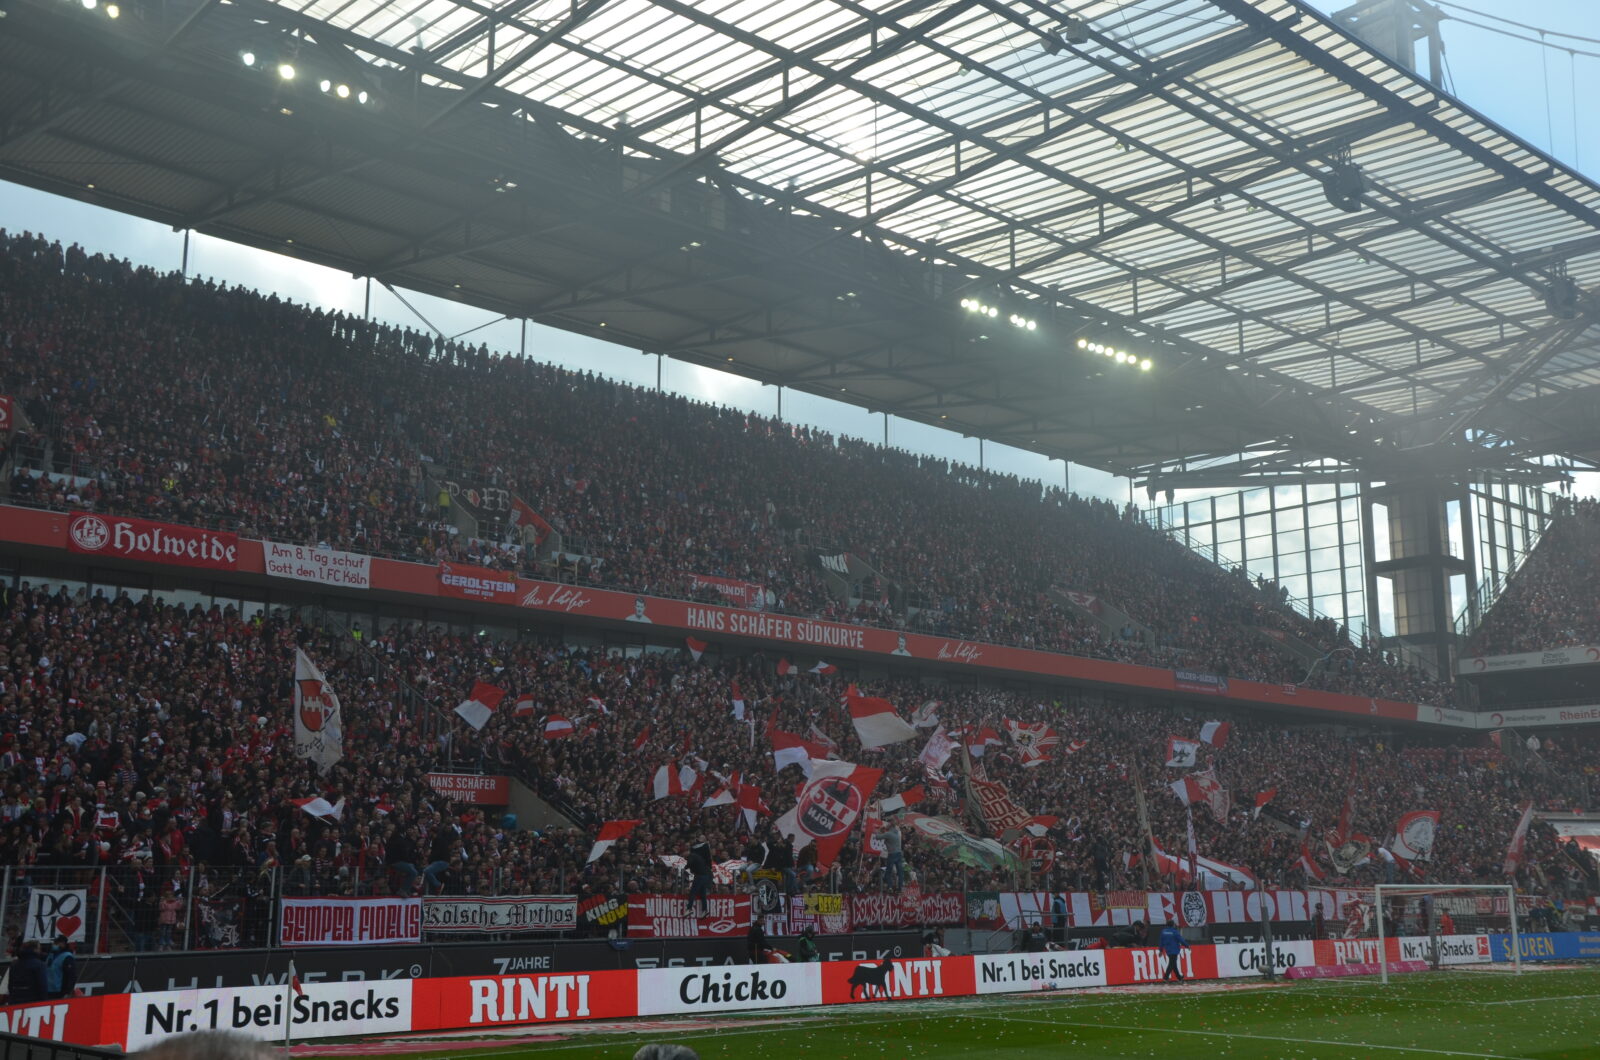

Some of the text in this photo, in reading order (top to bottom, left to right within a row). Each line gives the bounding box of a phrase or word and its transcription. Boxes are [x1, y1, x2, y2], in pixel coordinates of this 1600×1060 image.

[113, 522, 236, 563] Holweide
[272, 544, 365, 569] Am 8. Tag schuf
[268, 560, 292, 575] Gott
[296, 565, 316, 579] den
[343, 570, 367, 585] Köln
[441, 573, 516, 593] GEROLSTEIN
[687, 608, 864, 649] HANS SCHÄFER SÜDKURVE
[430, 776, 496, 790] HANS SCHÄFER
[37, 893, 82, 917] DO
[424, 903, 498, 926] Kölsche
[506, 902, 574, 925] Mythos
[585, 898, 619, 922] KING
[598, 902, 628, 925] NOW
[1000, 892, 1180, 930] WILDE
[282, 904, 354, 942] SEMPER
[358, 904, 420, 941] FIDELIS
[653, 918, 699, 937] STADION
[1442, 939, 1474, 957] Snacks
[494, 956, 550, 975] 7 JAHRE
[1021, 958, 1046, 980] bei
[1049, 956, 1100, 979] Snacks
[469, 975, 591, 1024] RINTI
[680, 971, 787, 1005] Chicko
[232, 993, 283, 1028] bei
[292, 989, 399, 1024] Snacks
[0, 1003, 69, 1042] NTI
